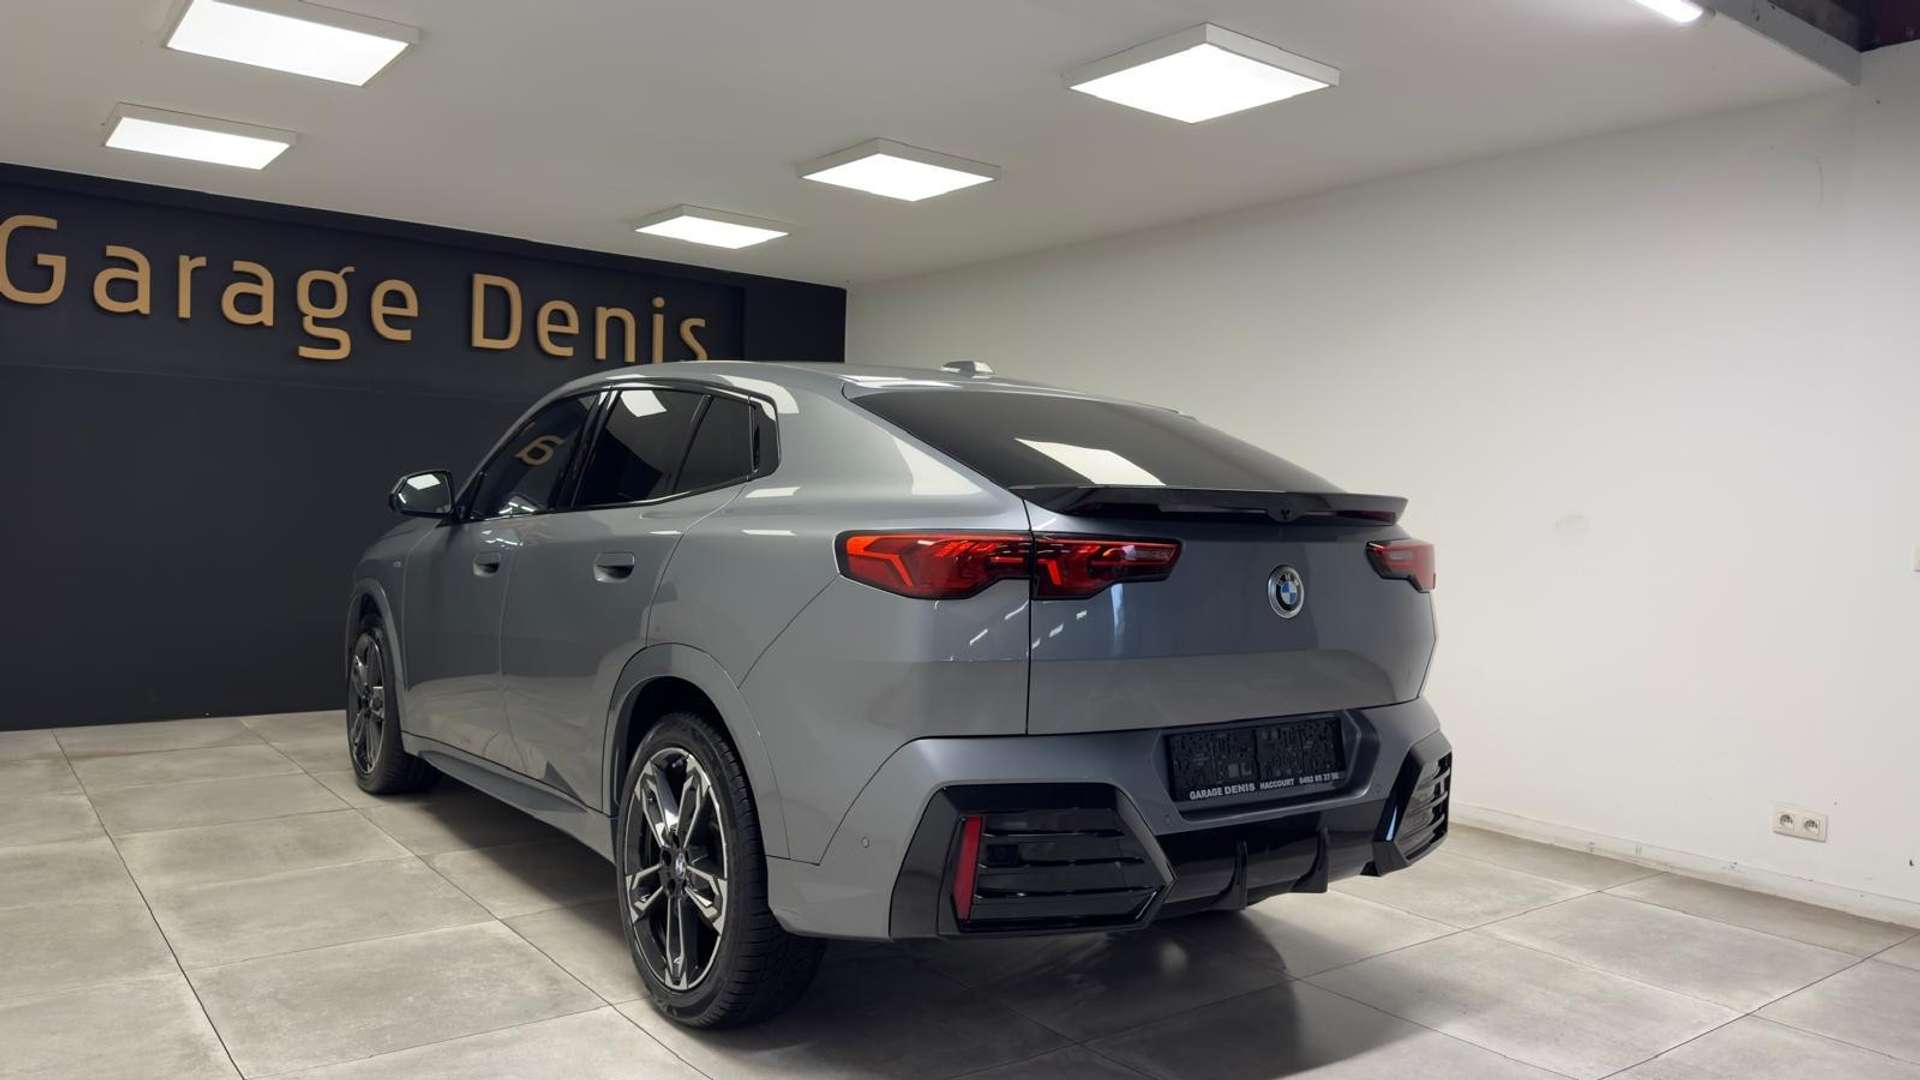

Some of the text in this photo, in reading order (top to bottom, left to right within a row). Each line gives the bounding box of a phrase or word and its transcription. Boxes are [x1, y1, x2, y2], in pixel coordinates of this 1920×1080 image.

[0, 215, 708, 362] Garage Denis
[1189, 787, 1223, 800] GARAGE
[1224, 783, 1256, 795] DENIS
